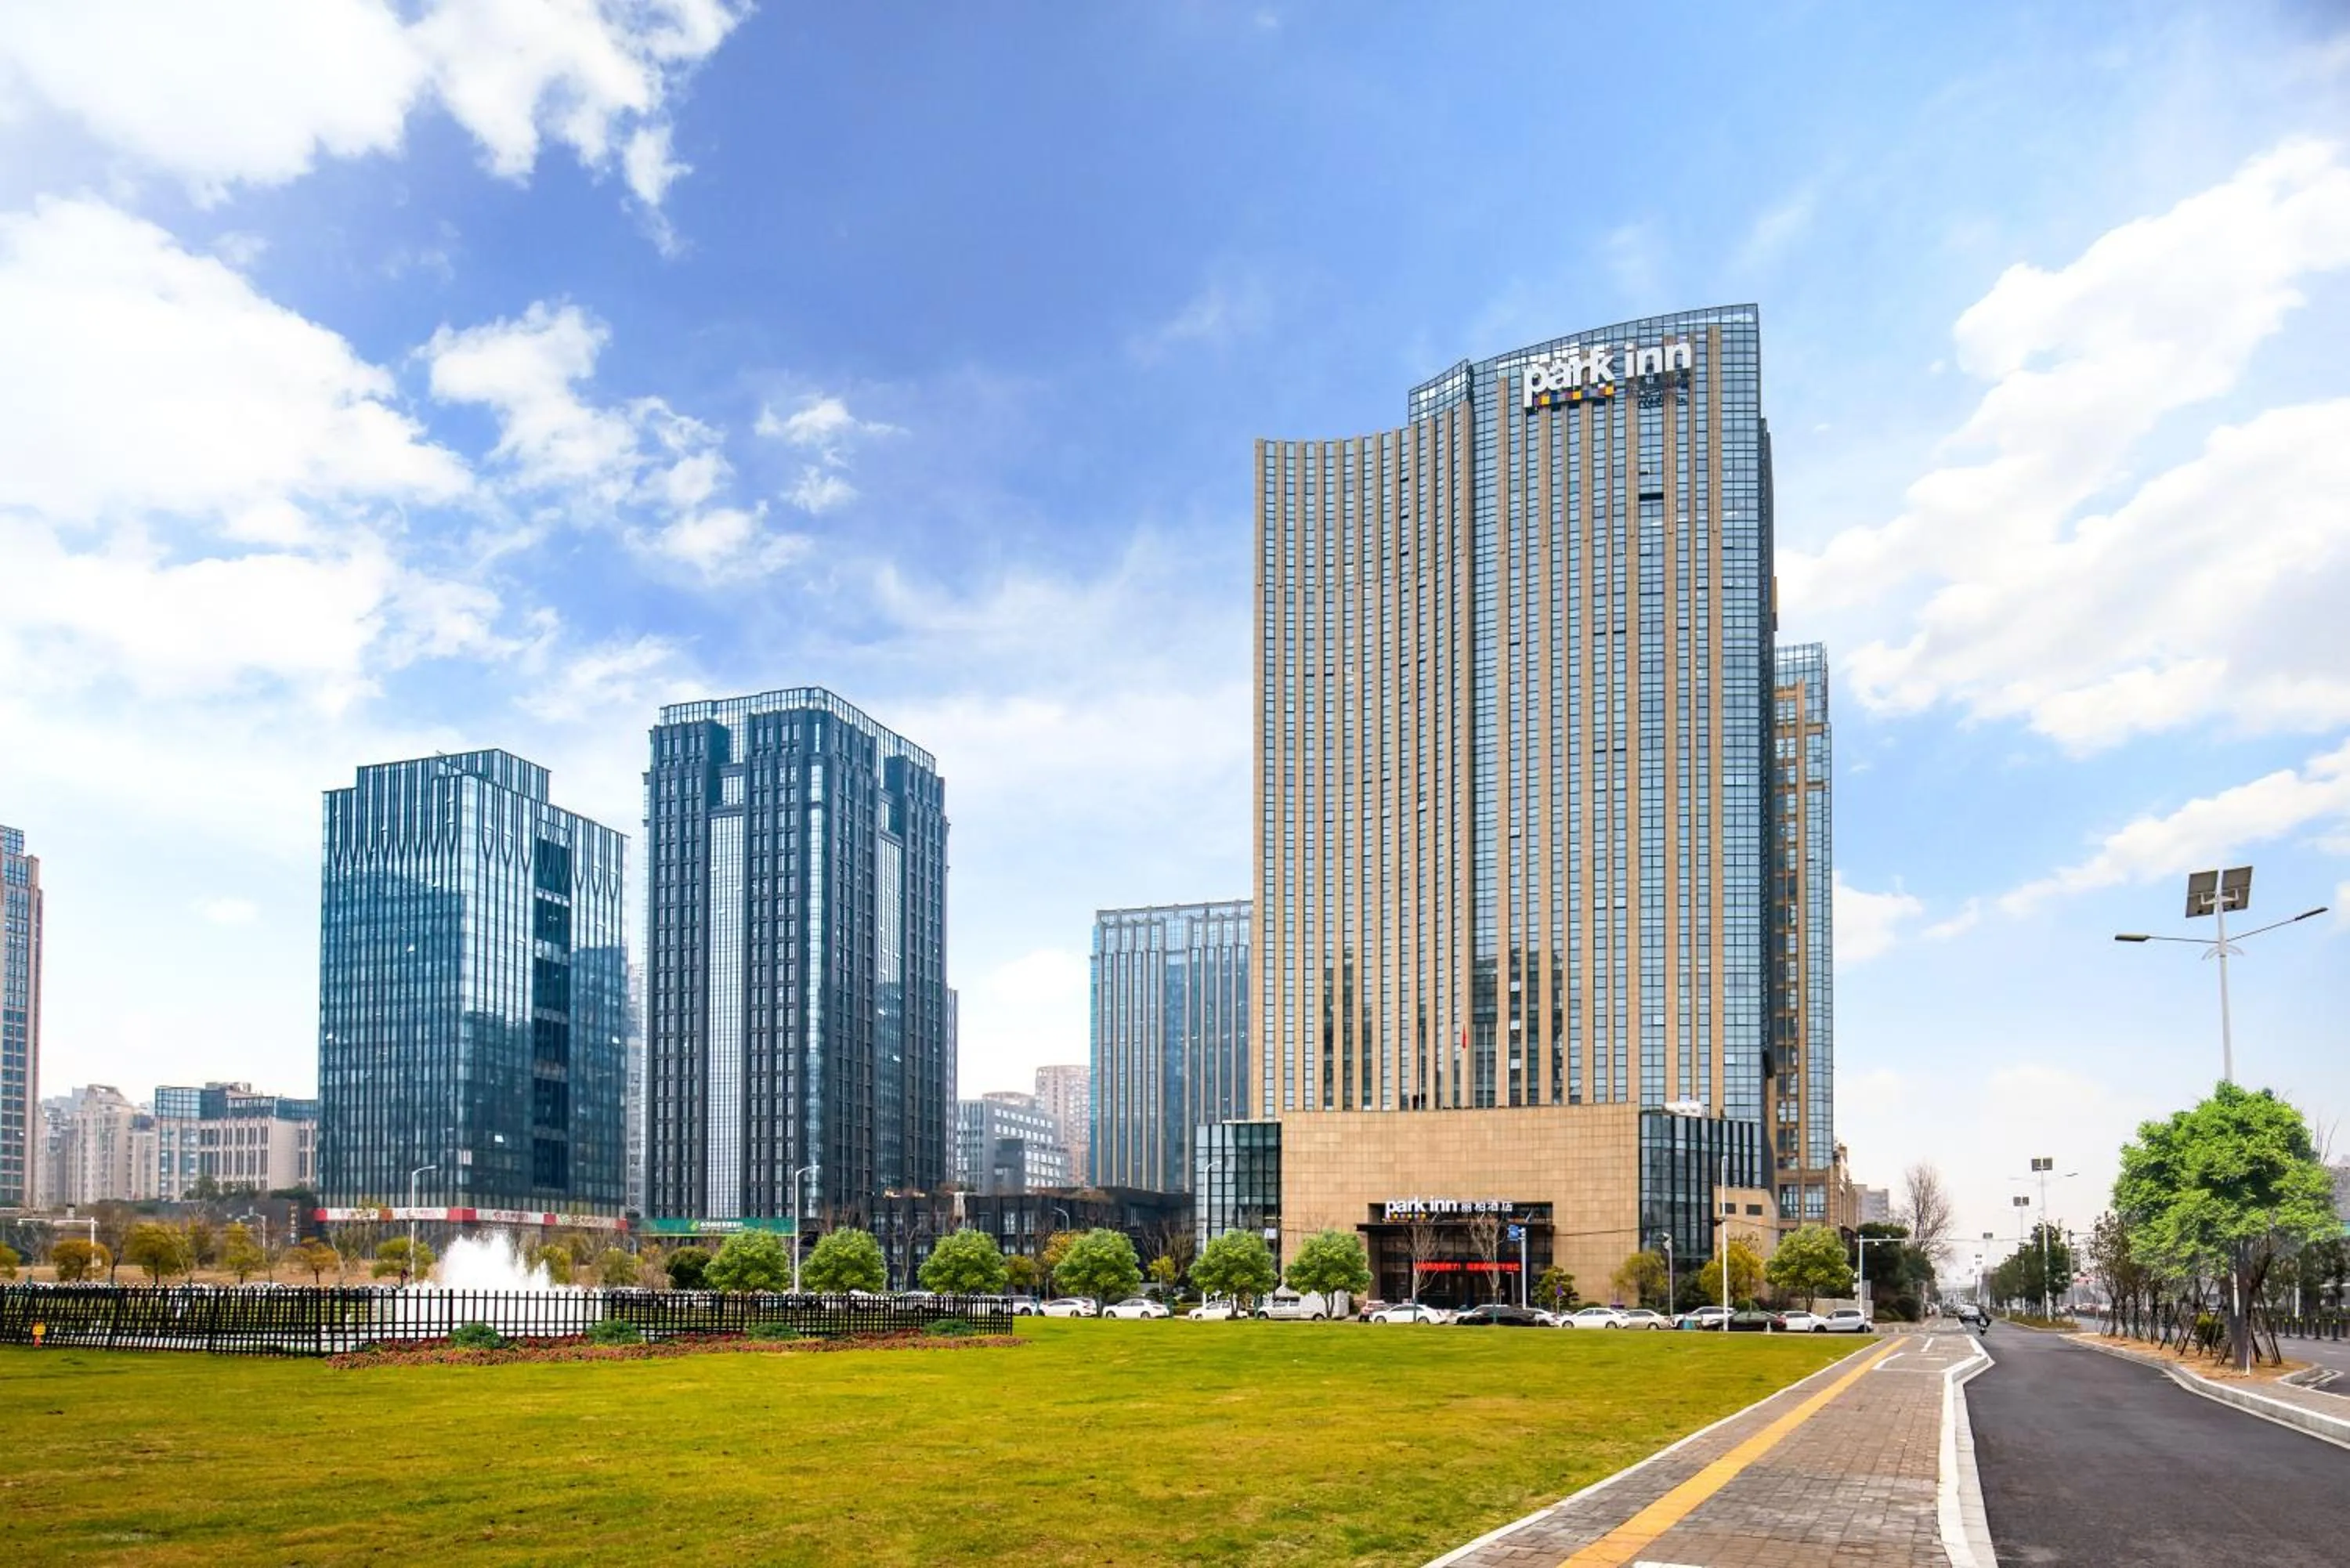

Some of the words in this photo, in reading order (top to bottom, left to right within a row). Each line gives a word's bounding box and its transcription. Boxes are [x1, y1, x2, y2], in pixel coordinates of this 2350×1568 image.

[1523, 345, 1615, 407] park
[1624, 341, 1691, 378] inn
[1385, 1196, 1426, 1219] park
[1430, 1195, 1457, 1212] inn
